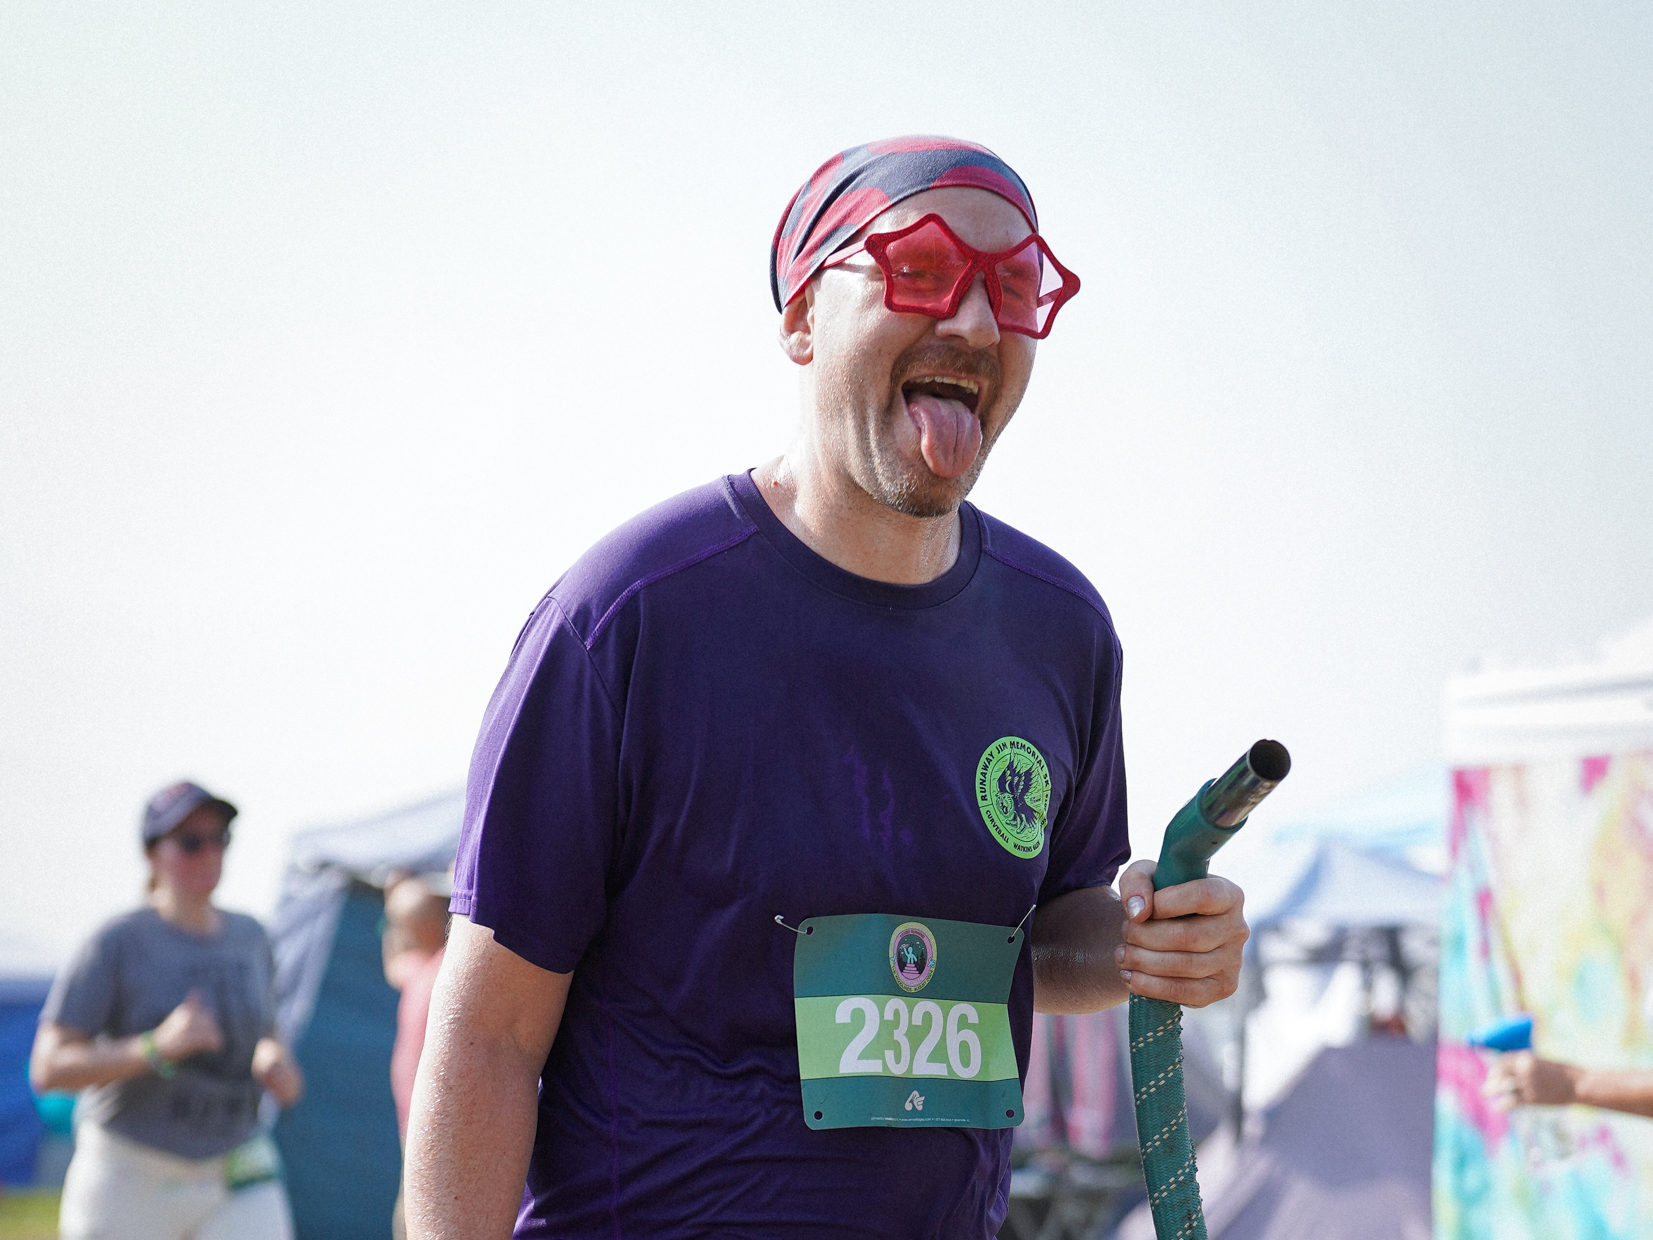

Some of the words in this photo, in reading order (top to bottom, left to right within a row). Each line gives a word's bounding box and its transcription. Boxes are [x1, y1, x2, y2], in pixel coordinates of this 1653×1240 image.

[979, 751, 996, 802] RUNAWAY
[995, 741, 1009, 755] JIM
[1009, 740, 1045, 770] MEMORIAL
[985, 809, 1010, 844] CURVEBALL
[835, 996, 982, 1079] 2326
